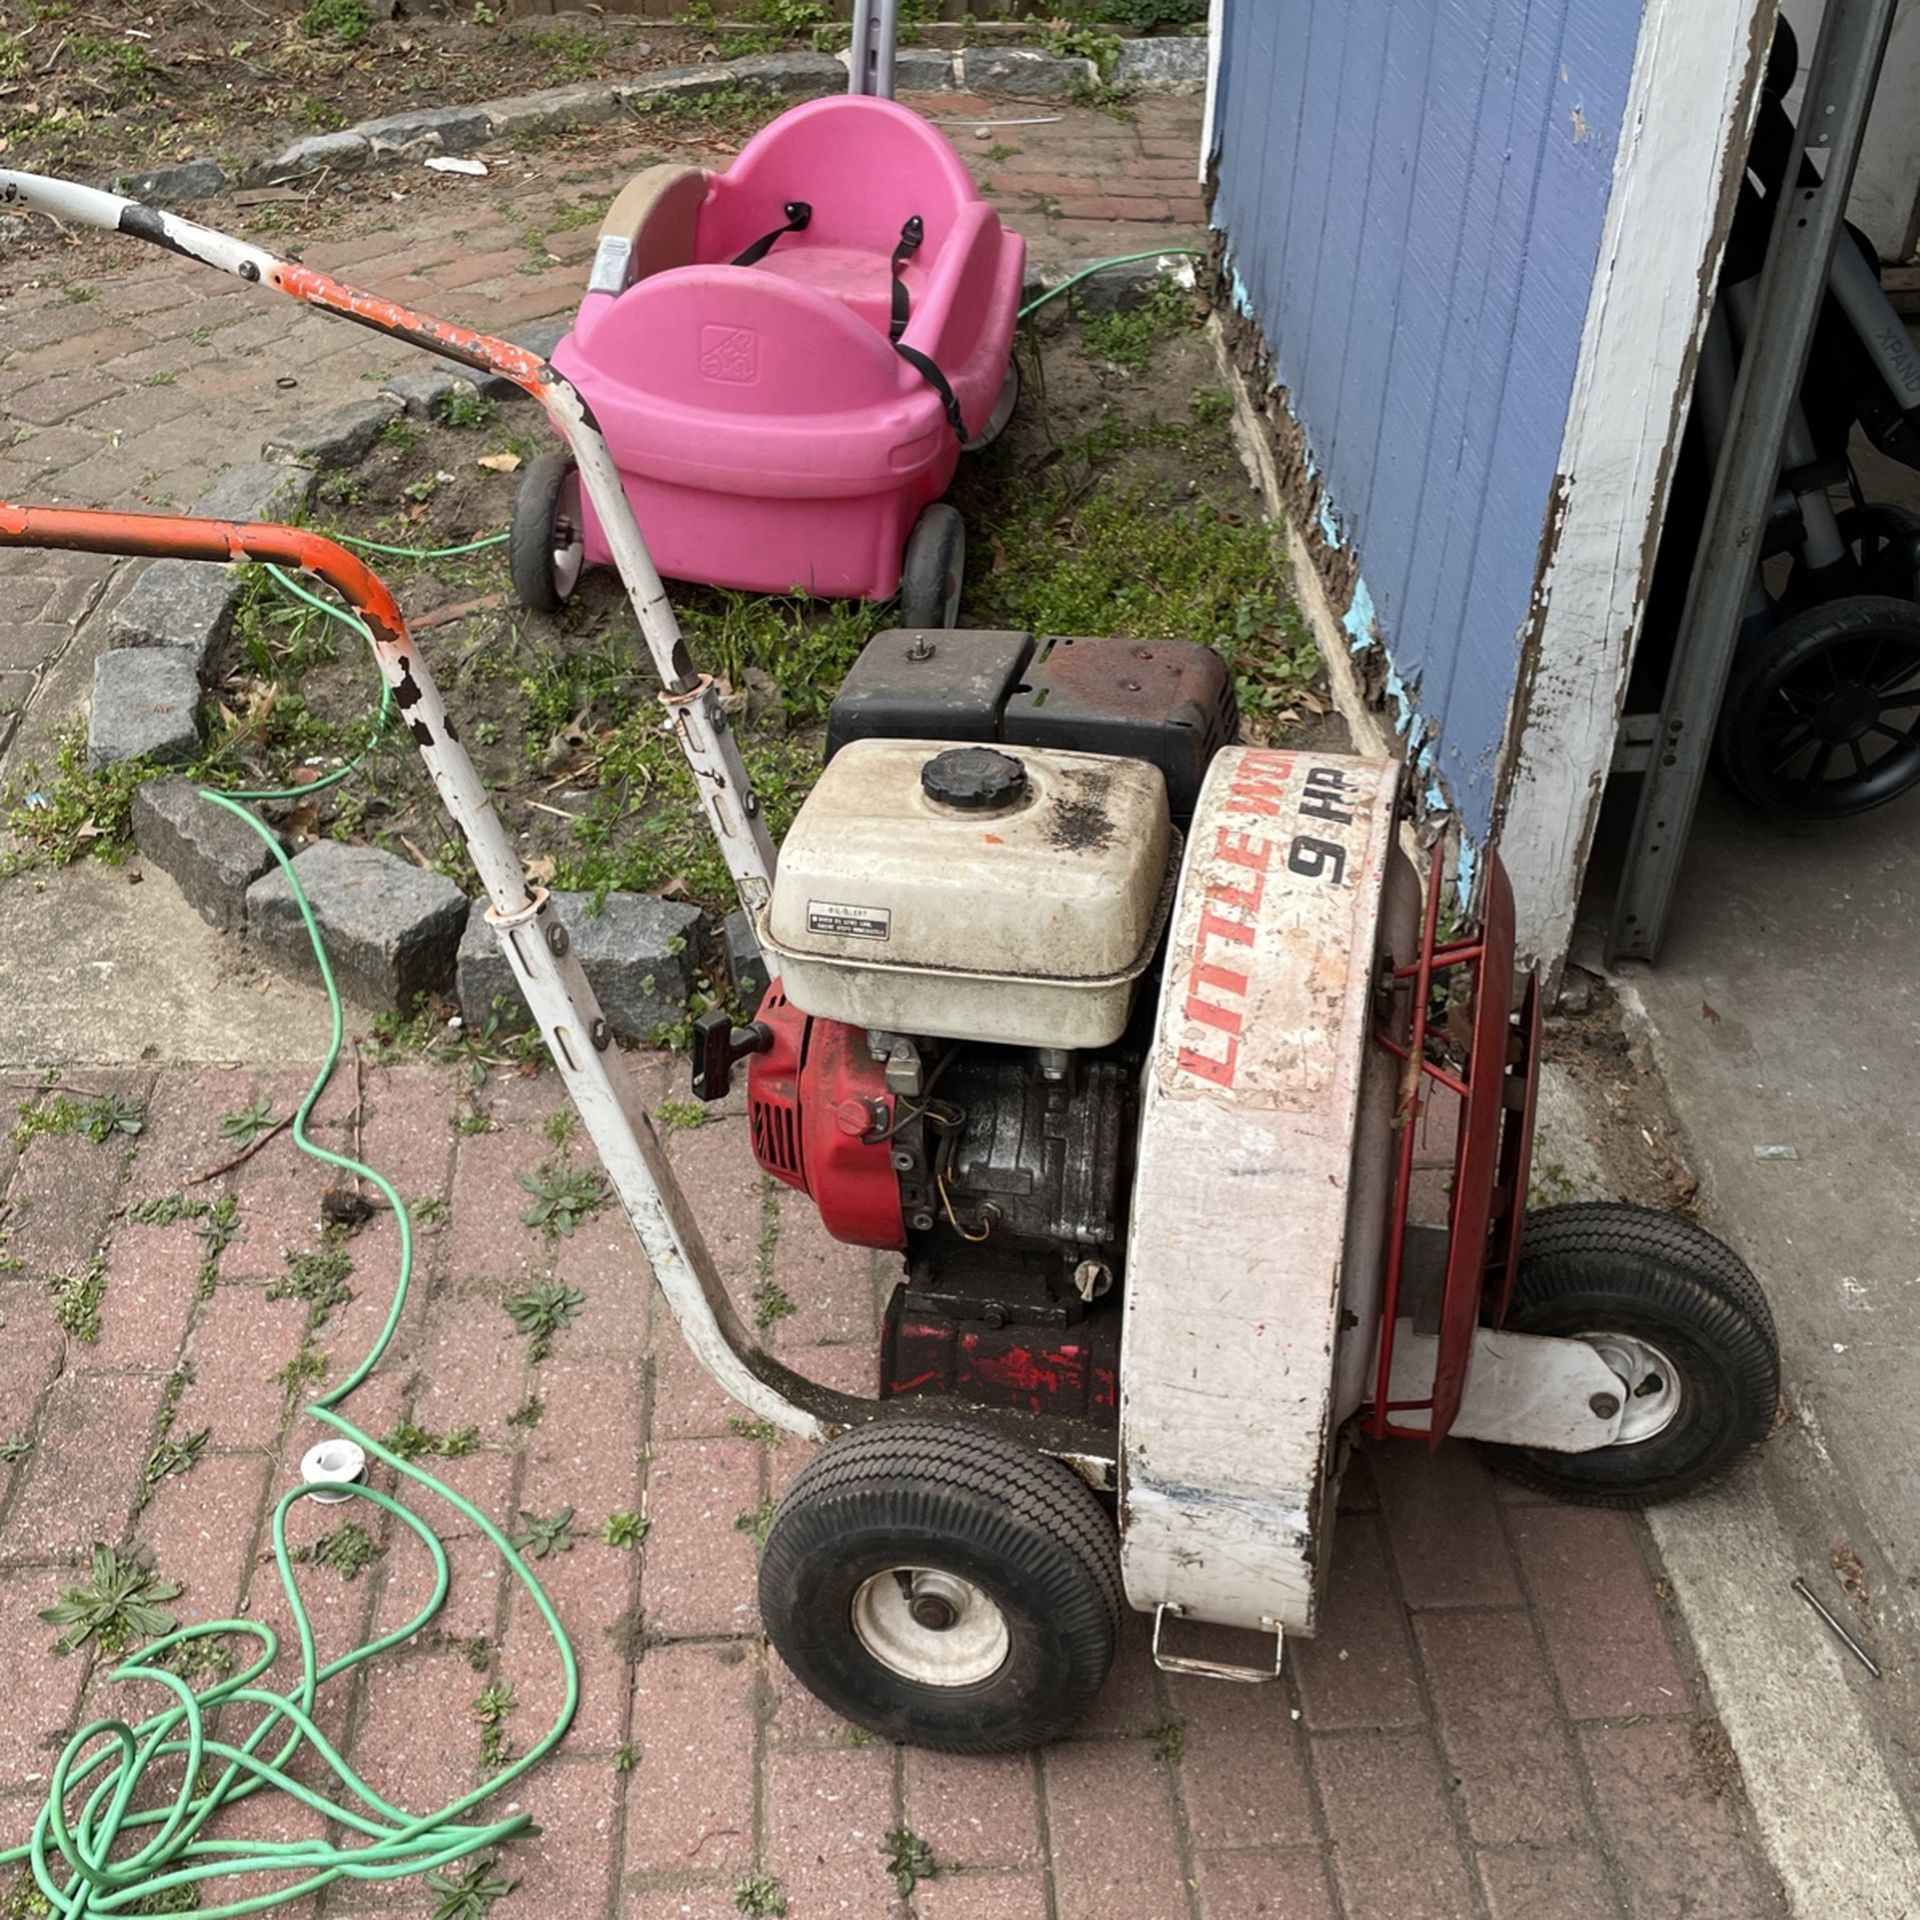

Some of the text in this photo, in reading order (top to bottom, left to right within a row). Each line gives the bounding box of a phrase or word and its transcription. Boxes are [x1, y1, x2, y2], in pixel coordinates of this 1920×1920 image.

[1287, 767, 1355, 885] 9 HP
[1176, 826, 1273, 1089] LITTLE
